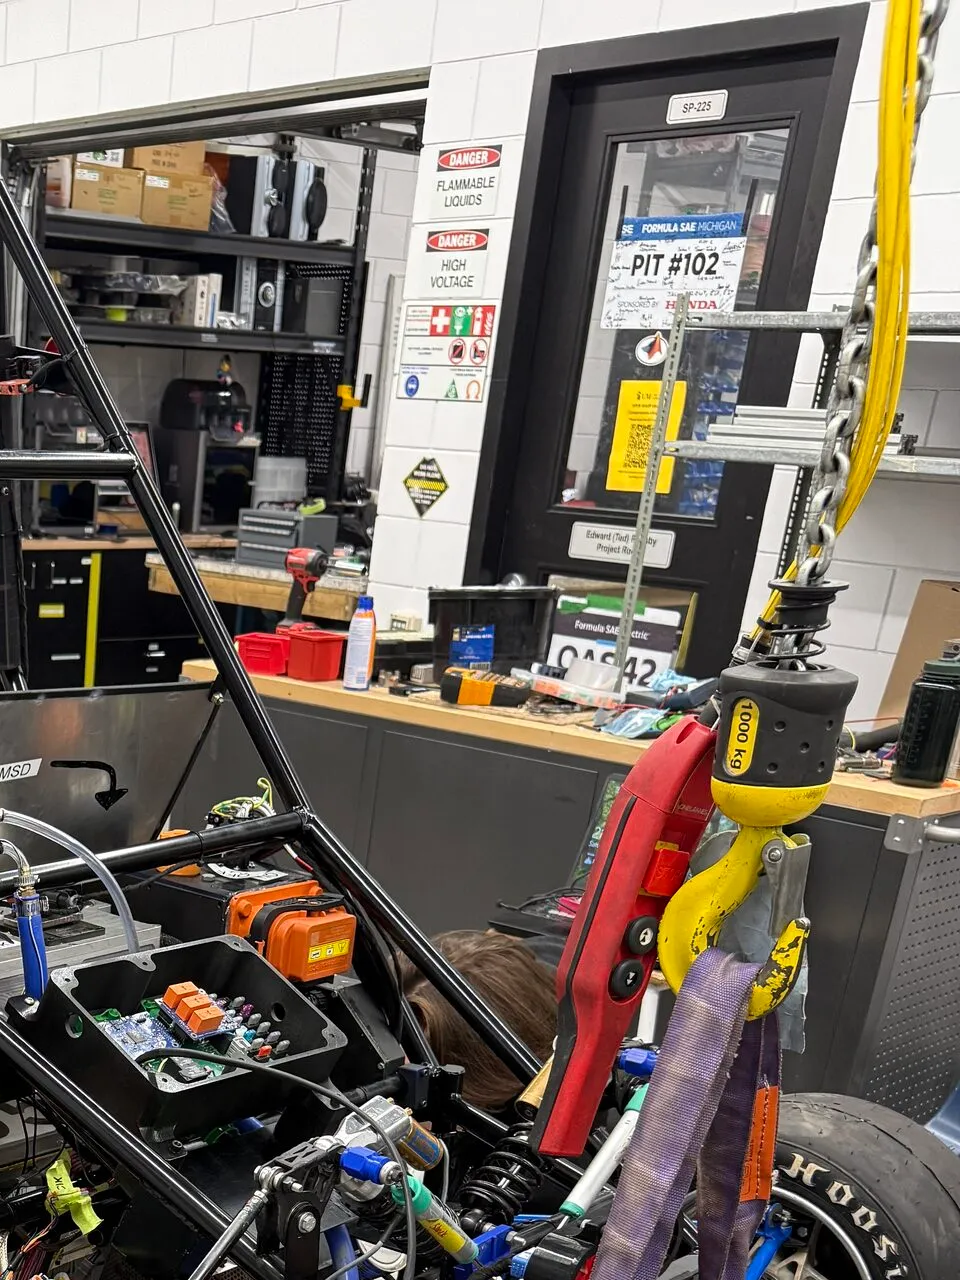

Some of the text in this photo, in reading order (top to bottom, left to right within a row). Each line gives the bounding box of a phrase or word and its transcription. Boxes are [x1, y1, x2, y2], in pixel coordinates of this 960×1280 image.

[682, 101, 711, 113] SP-225
[449, 151, 488, 167] DANGER
[437, 176, 496, 192] FLAMMABLE
[444, 194, 482, 207] LIQUIDS
[641, 220, 737, 234] FORMULA SAE MICHIGAN
[438, 234, 476, 248] DANGER
[441, 259, 467, 272] HIGH
[631, 252, 720, 276] PIT #102
[430, 275, 475, 288] VOLTAGE
[617, 300, 651, 309] SPONSORED
[665, 300, 718, 310] HNDA
[586, 530, 611, 540] Edward
[596, 543, 620, 554] Project
[574, 620, 604, 633] Formula
[605, 624, 620, 635] SAE
[730, 703, 753, 770] 1000 kg
[0, 763, 31, 780] MSD
